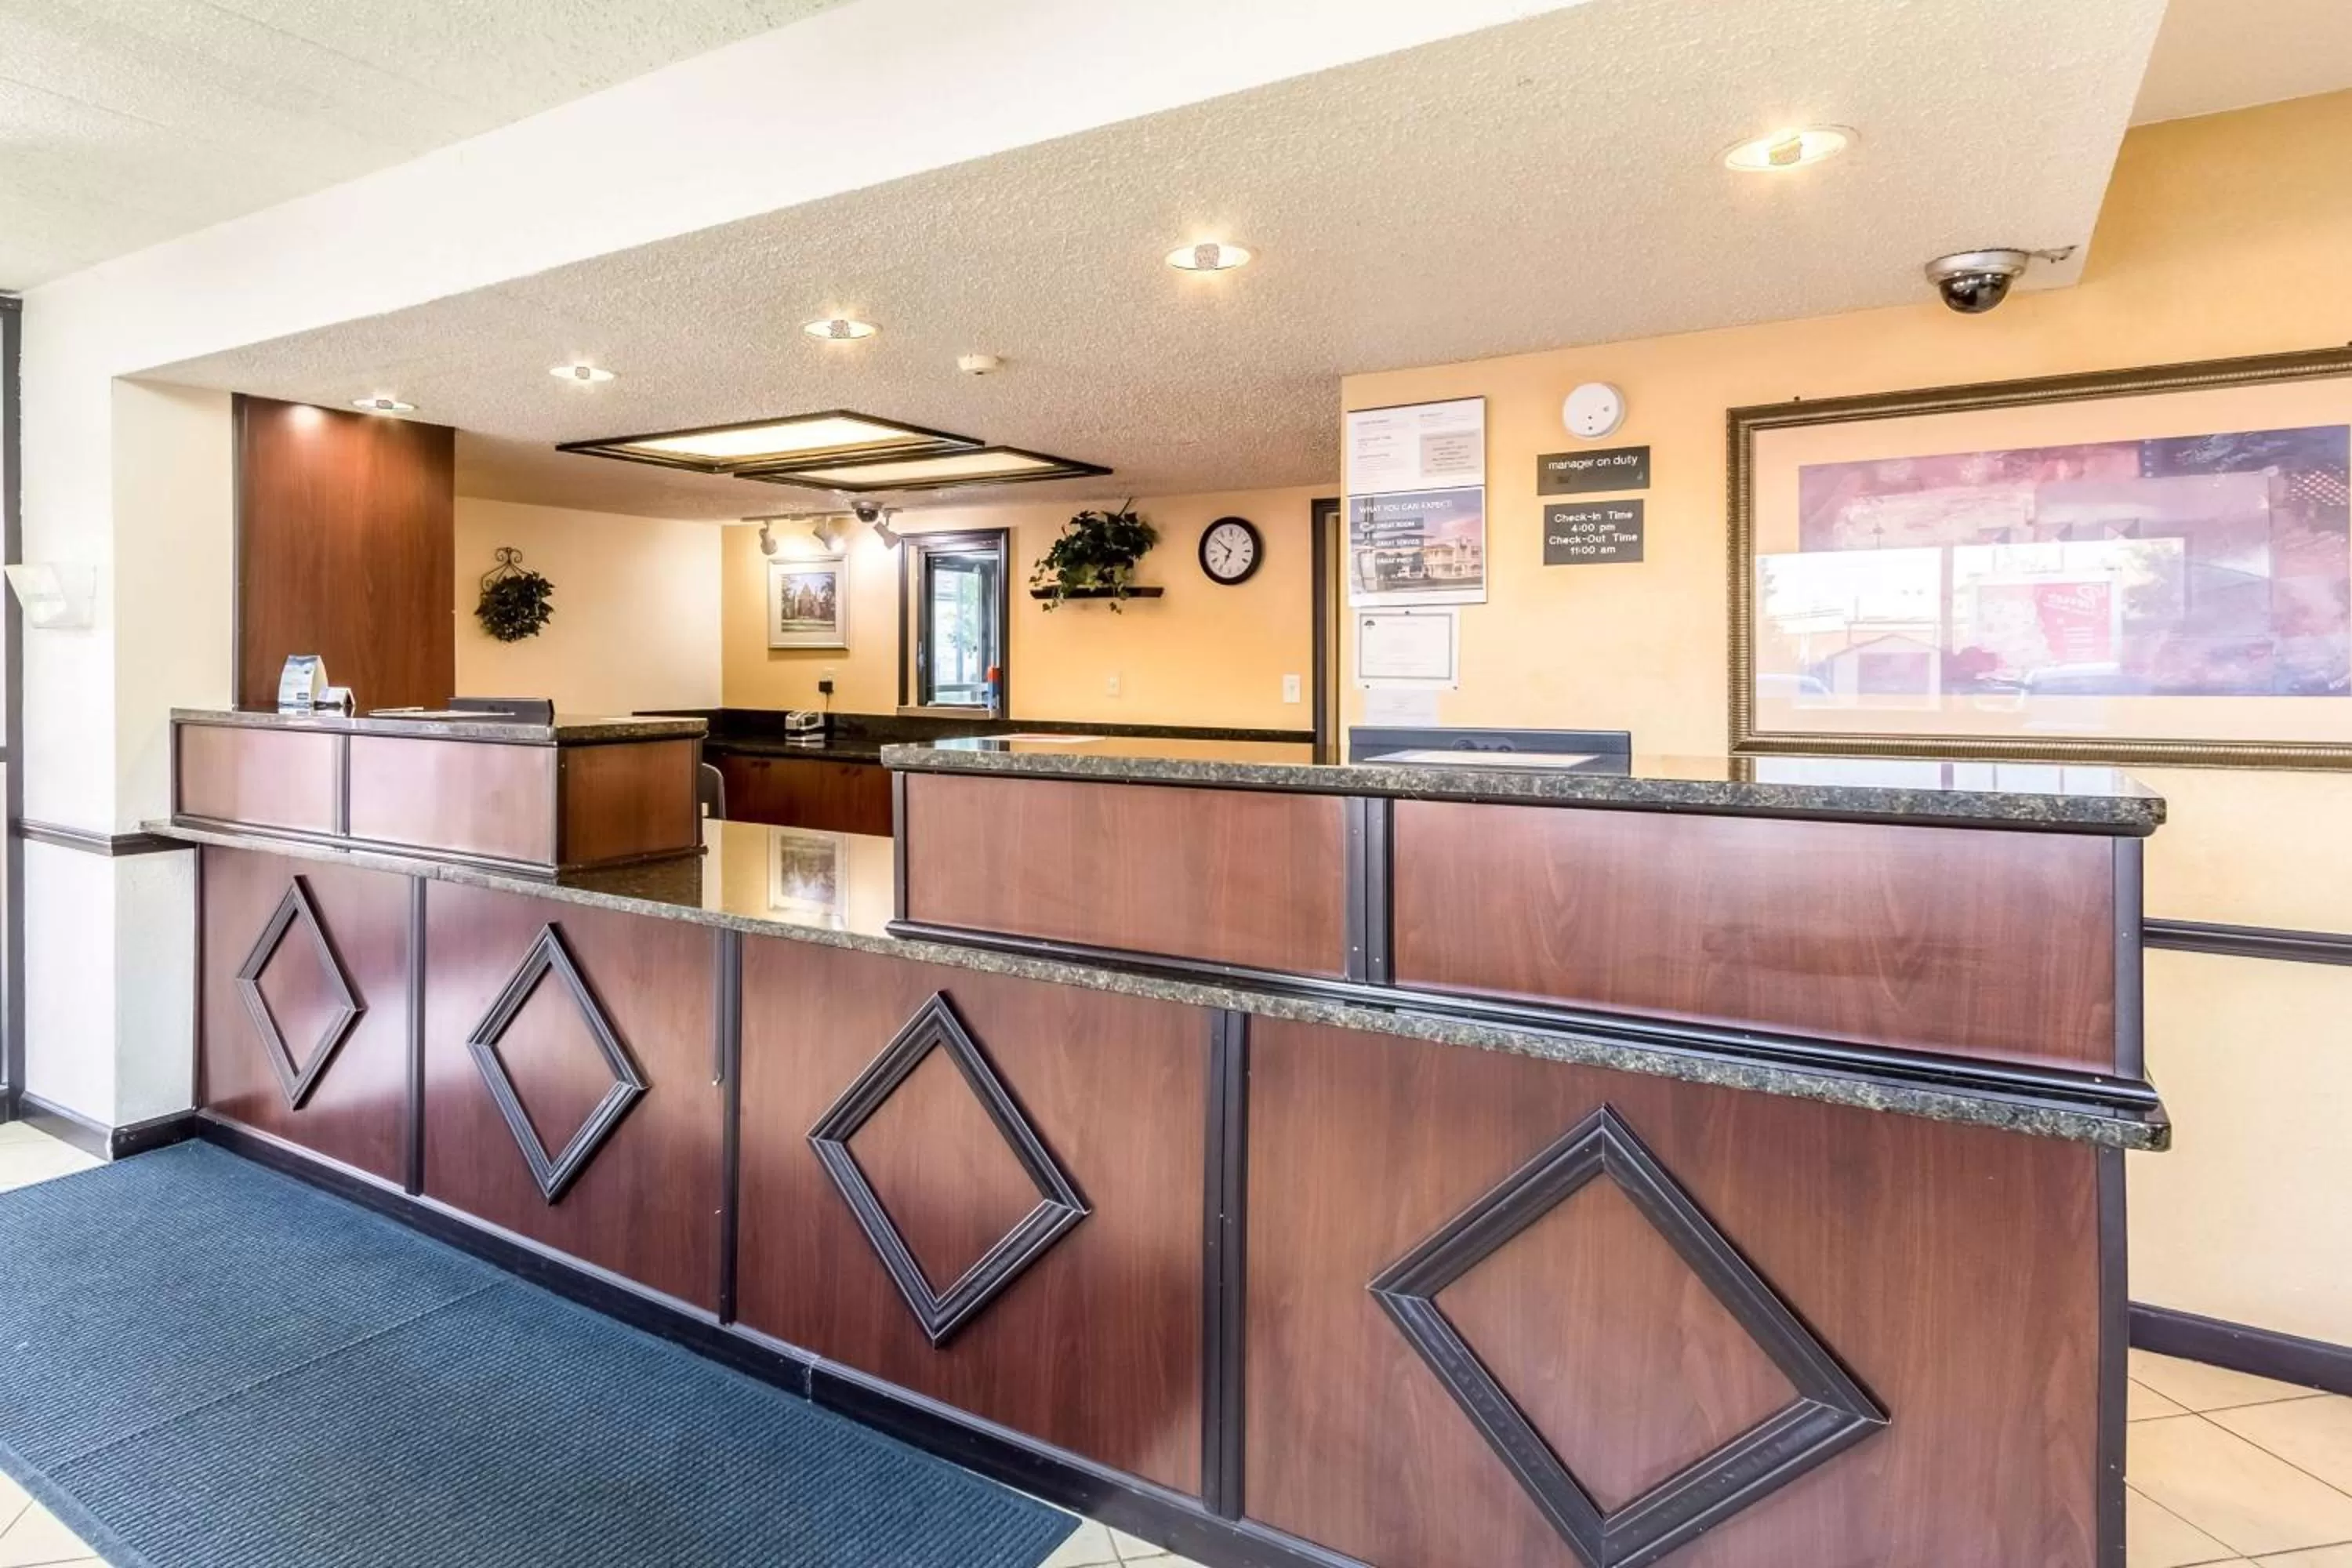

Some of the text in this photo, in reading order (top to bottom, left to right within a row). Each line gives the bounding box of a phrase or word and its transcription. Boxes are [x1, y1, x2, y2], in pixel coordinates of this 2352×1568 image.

[1548, 455, 1638, 470] manager on duty
[1359, 504, 1381, 514] WHAT
[1607, 510, 1633, 520] Time
[1599, 524, 1616, 532] pm
[1548, 533, 1638, 545] Check-Out Time
[1570, 546, 1595, 555] 11:00
